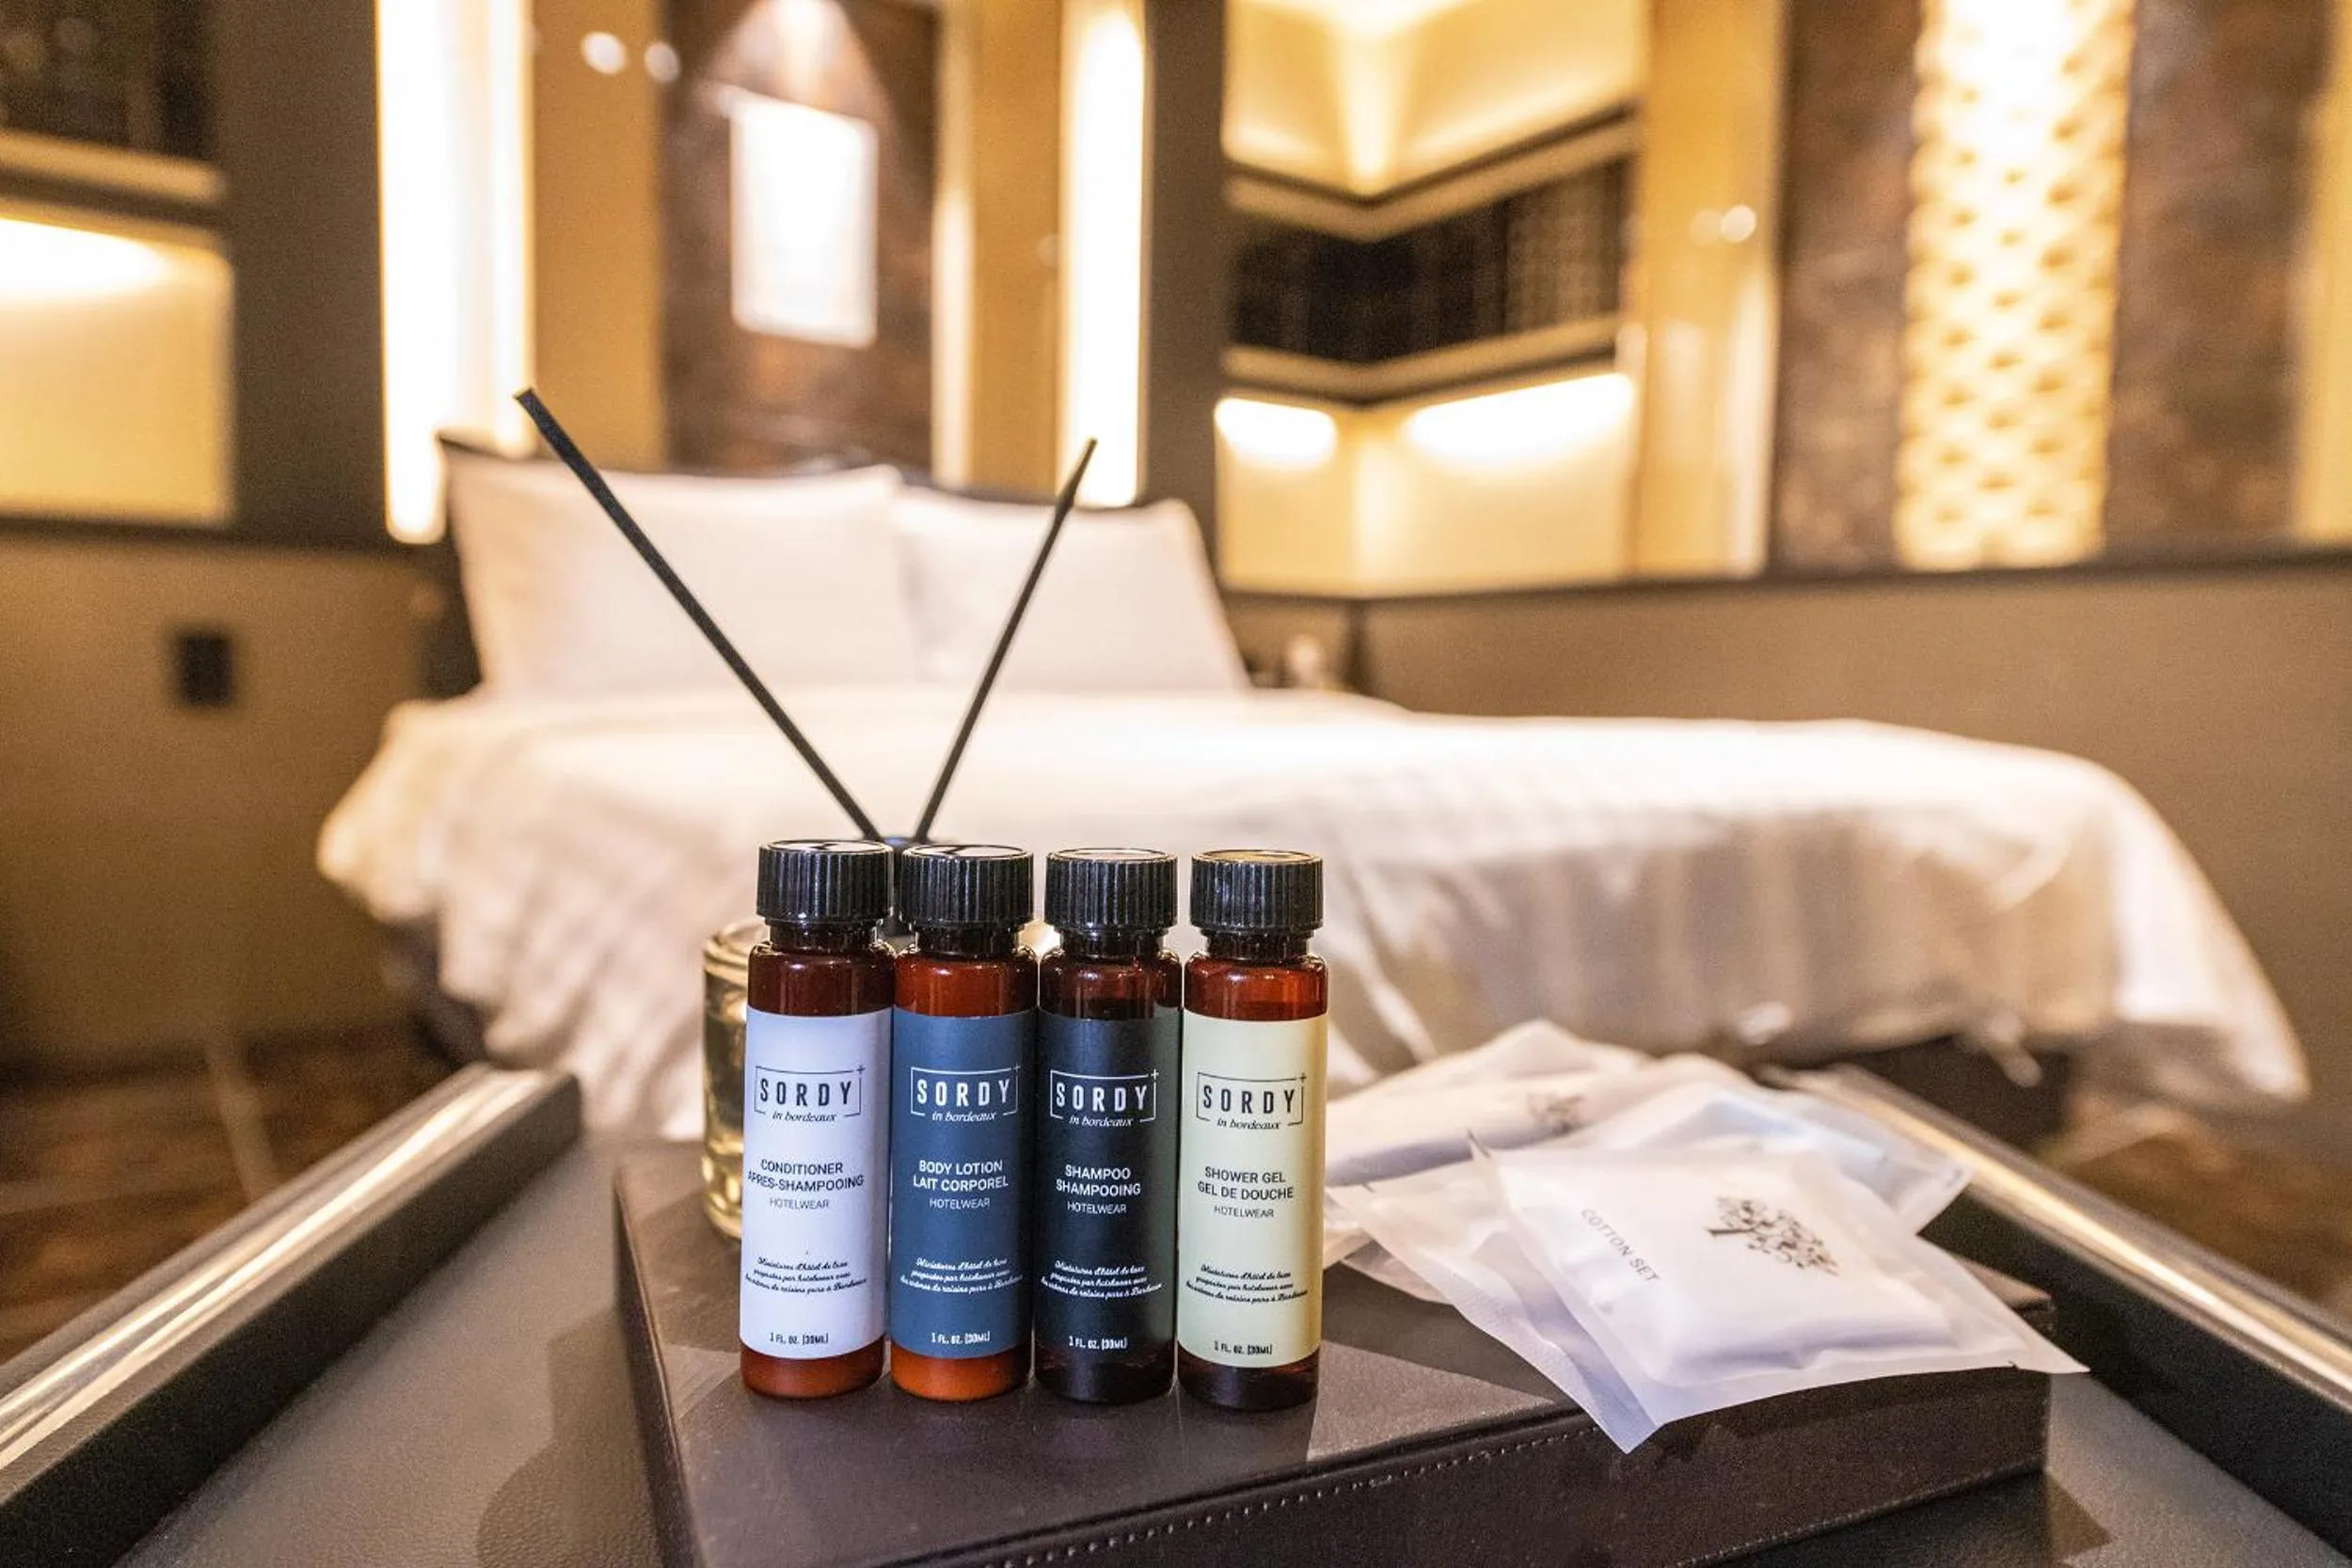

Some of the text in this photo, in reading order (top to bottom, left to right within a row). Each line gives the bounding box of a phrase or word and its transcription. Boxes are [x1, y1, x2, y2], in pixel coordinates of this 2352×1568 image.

[760, 1078, 851, 1106] SORDY
[917, 1079, 1009, 1107] SORDY
[1057, 1082, 1147, 1112] SORDY
[1203, 1085, 1295, 1114] SORDY
[785, 1112, 836, 1122] bordeaux
[945, 1111, 996, 1122] bordeaux
[1082, 1116, 1133, 1127] bordeaux
[1230, 1119, 1280, 1130] bordeaux
[760, 1158, 843, 1175] CONDITIONER
[919, 1159, 1003, 1175] BODY LOTION
[1065, 1164, 1131, 1180] SHAMPOO
[1204, 1166, 1286, 1183] SHOWER GEL
[914, 1175, 1009, 1192] LAIT CORPOREL
[1057, 1179, 1141, 1196] SHAMPOOING
[1198, 1180, 1295, 1200] GEL DE DOUCHE
[770, 1197, 829, 1210] HOTELWEAR
[930, 1197, 991, 1210] HOTELWEAR
[1067, 1201, 1127, 1214] HOTELWEAR
[1214, 1205, 1274, 1218] HOTELWEAR
[1581, 1208, 1660, 1280] COTTON SET
